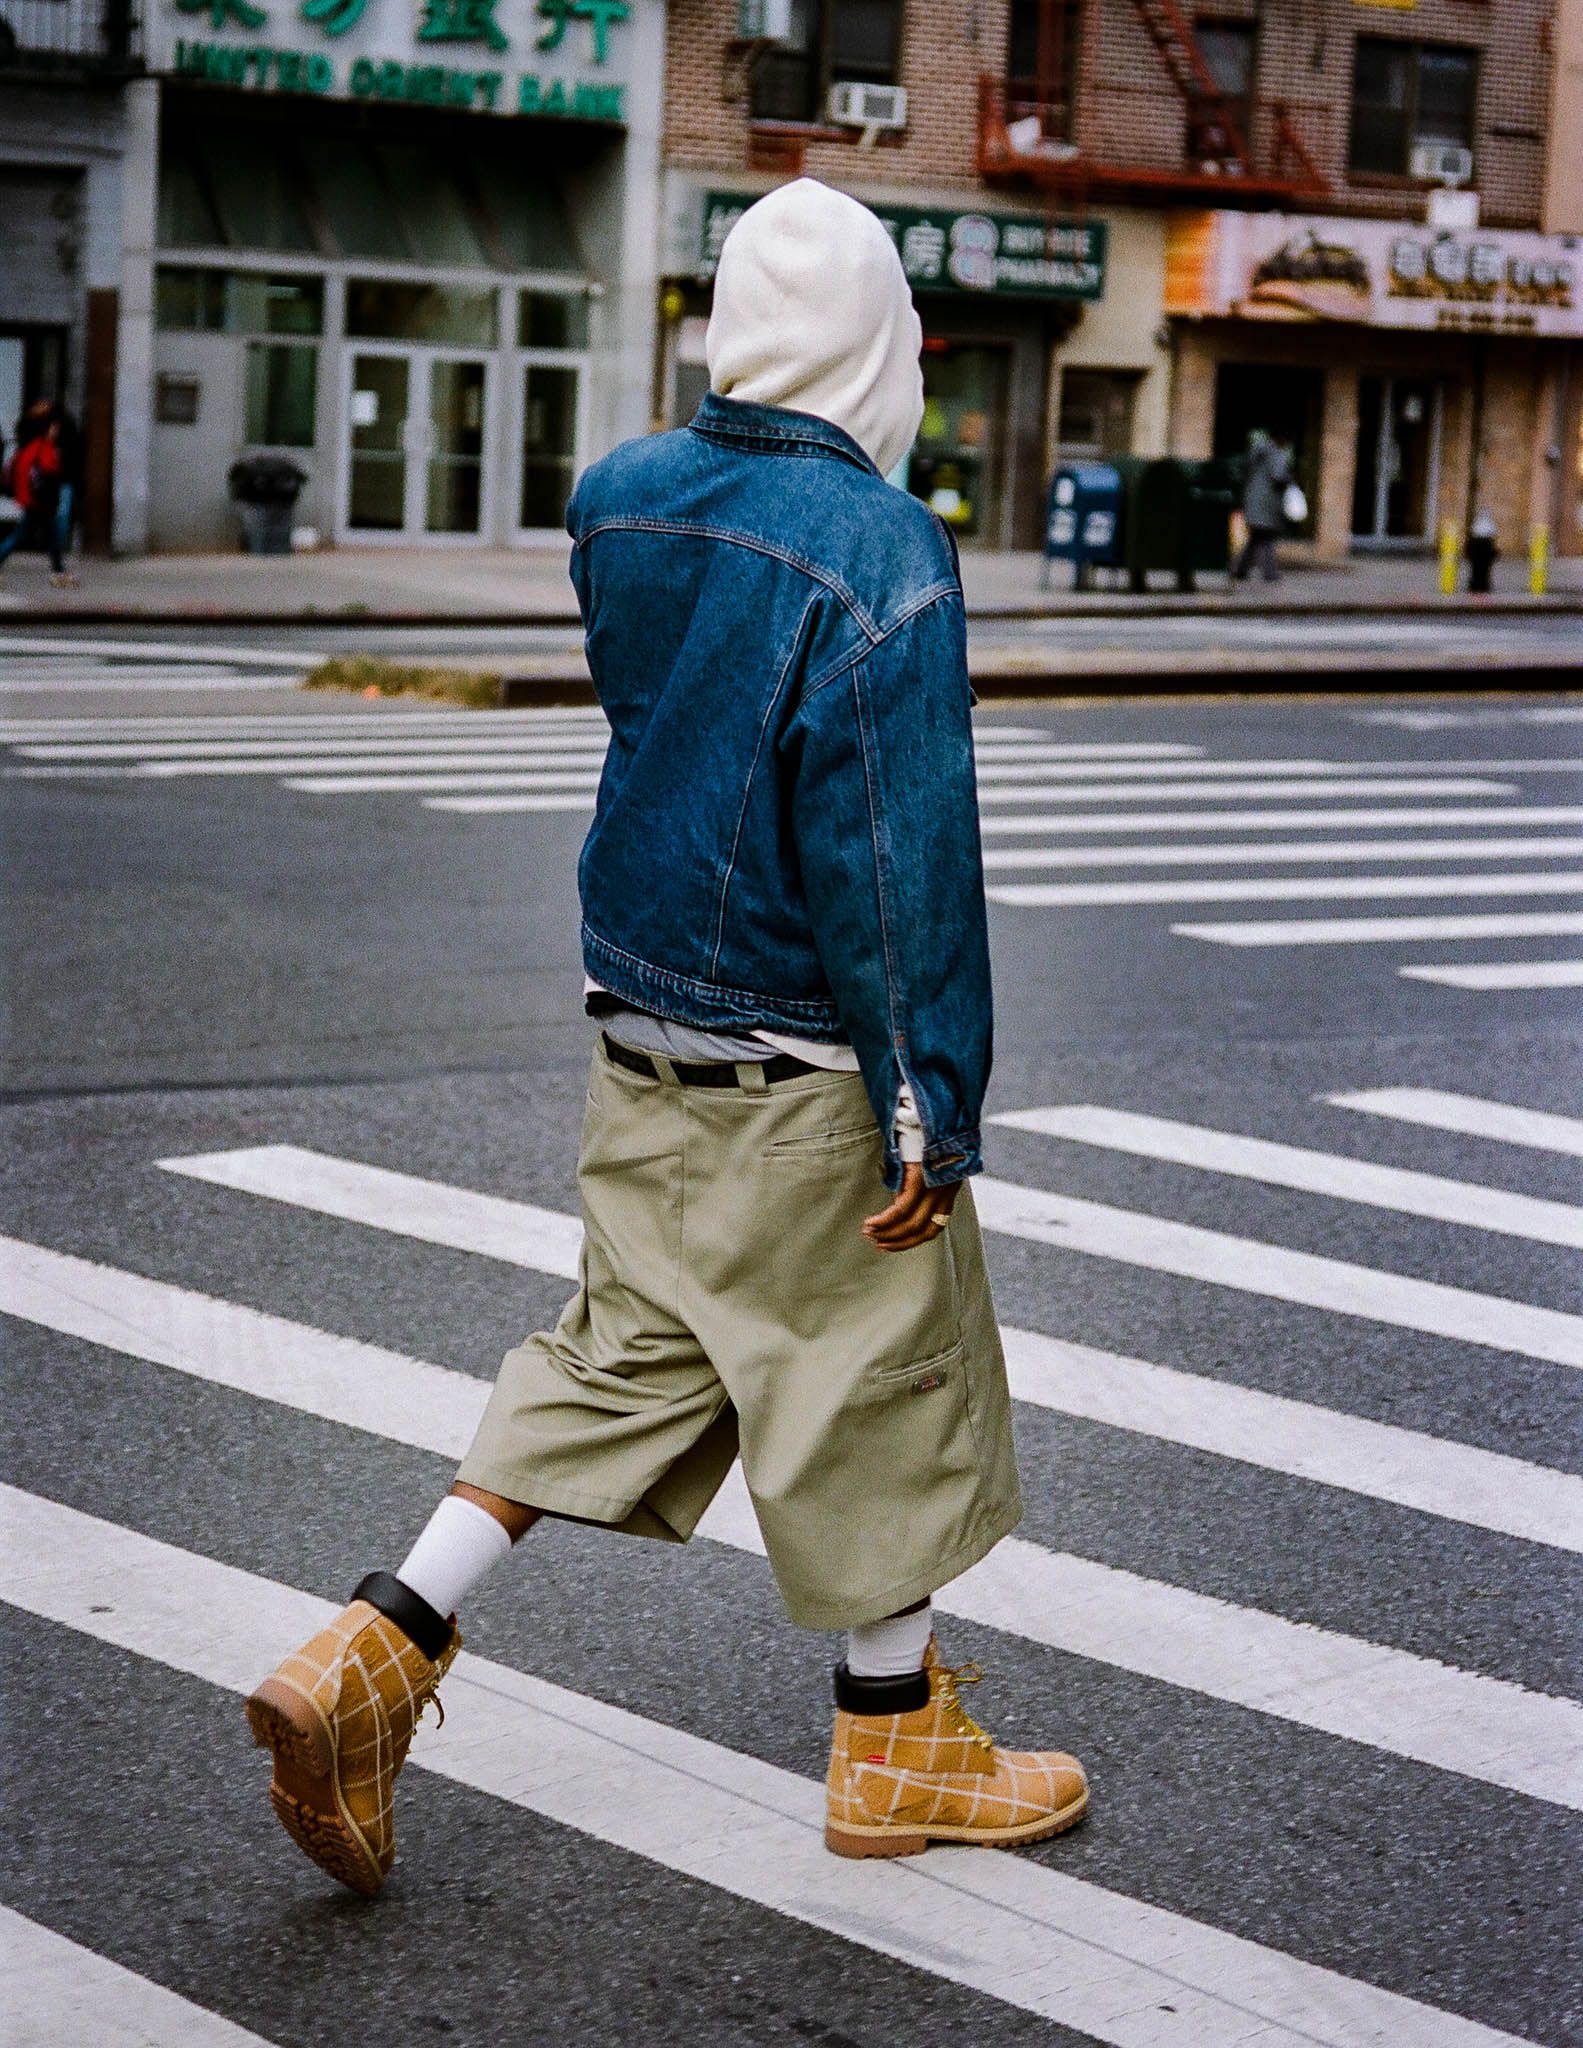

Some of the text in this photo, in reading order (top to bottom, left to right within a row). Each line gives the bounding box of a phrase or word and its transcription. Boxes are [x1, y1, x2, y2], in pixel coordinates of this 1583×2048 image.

[177, 39, 625, 119] UNITED ORIENT BANK
